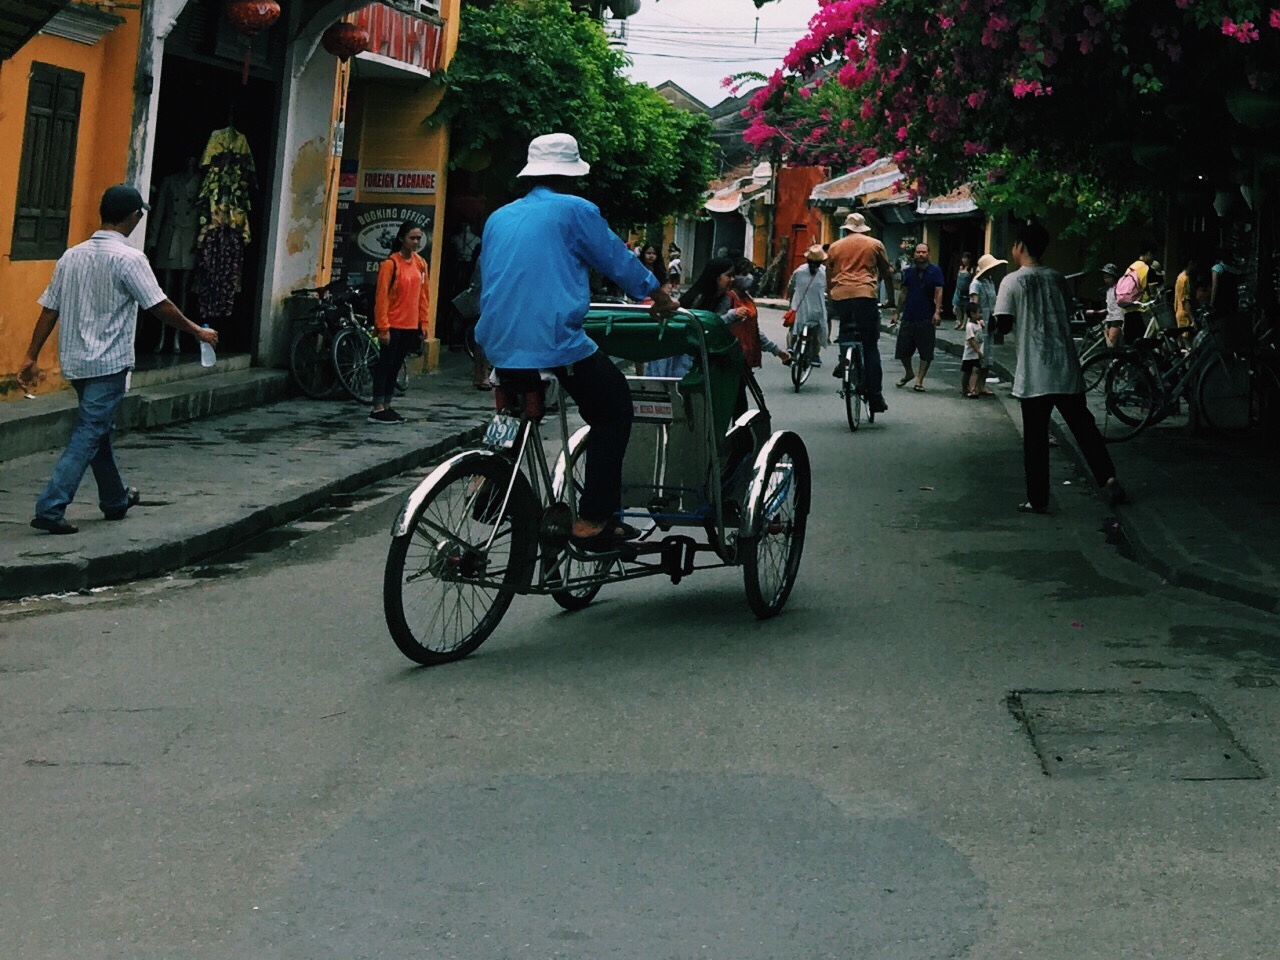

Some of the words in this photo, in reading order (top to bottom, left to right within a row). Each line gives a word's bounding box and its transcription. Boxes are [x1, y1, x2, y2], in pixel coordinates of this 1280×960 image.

[364, 173, 395, 189] FOREIGN
[397, 173, 436, 189] EXCHANGE
[357, 208, 398, 226] BOOKING
[400, 208, 431, 228] OFFICE
